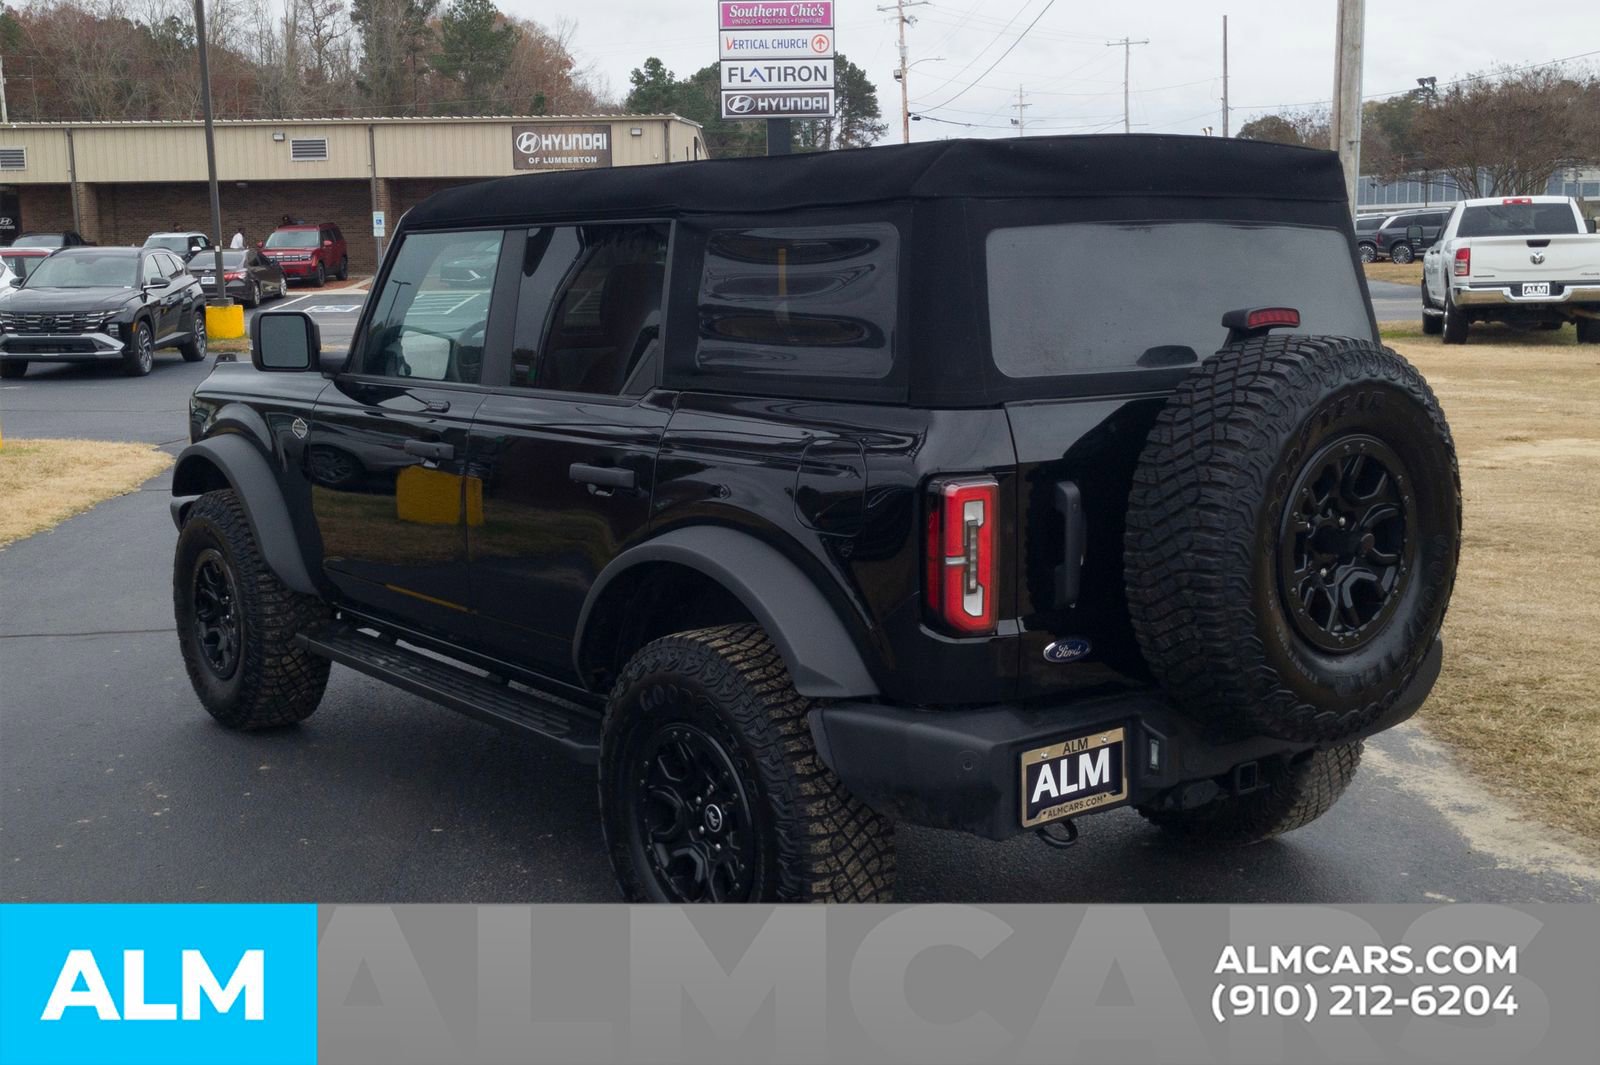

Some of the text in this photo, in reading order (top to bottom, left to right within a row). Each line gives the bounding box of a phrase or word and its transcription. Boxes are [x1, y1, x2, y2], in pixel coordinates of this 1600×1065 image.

[729, 3, 824, 17] Southern Chic's
[726, 36, 808, 50] VERTICAL CHURCH
[728, 66, 827, 83] FLATIRON
[758, 97, 827, 111] HYUNDAI
[541, 133, 607, 150] HYUNDAI
[543, 156, 597, 164] LUMBERTON
[1062, 737, 1089, 755] ALM
[1031, 747, 1110, 804] ALM
[1046, 796, 1104, 819] ALMCARS.COM
